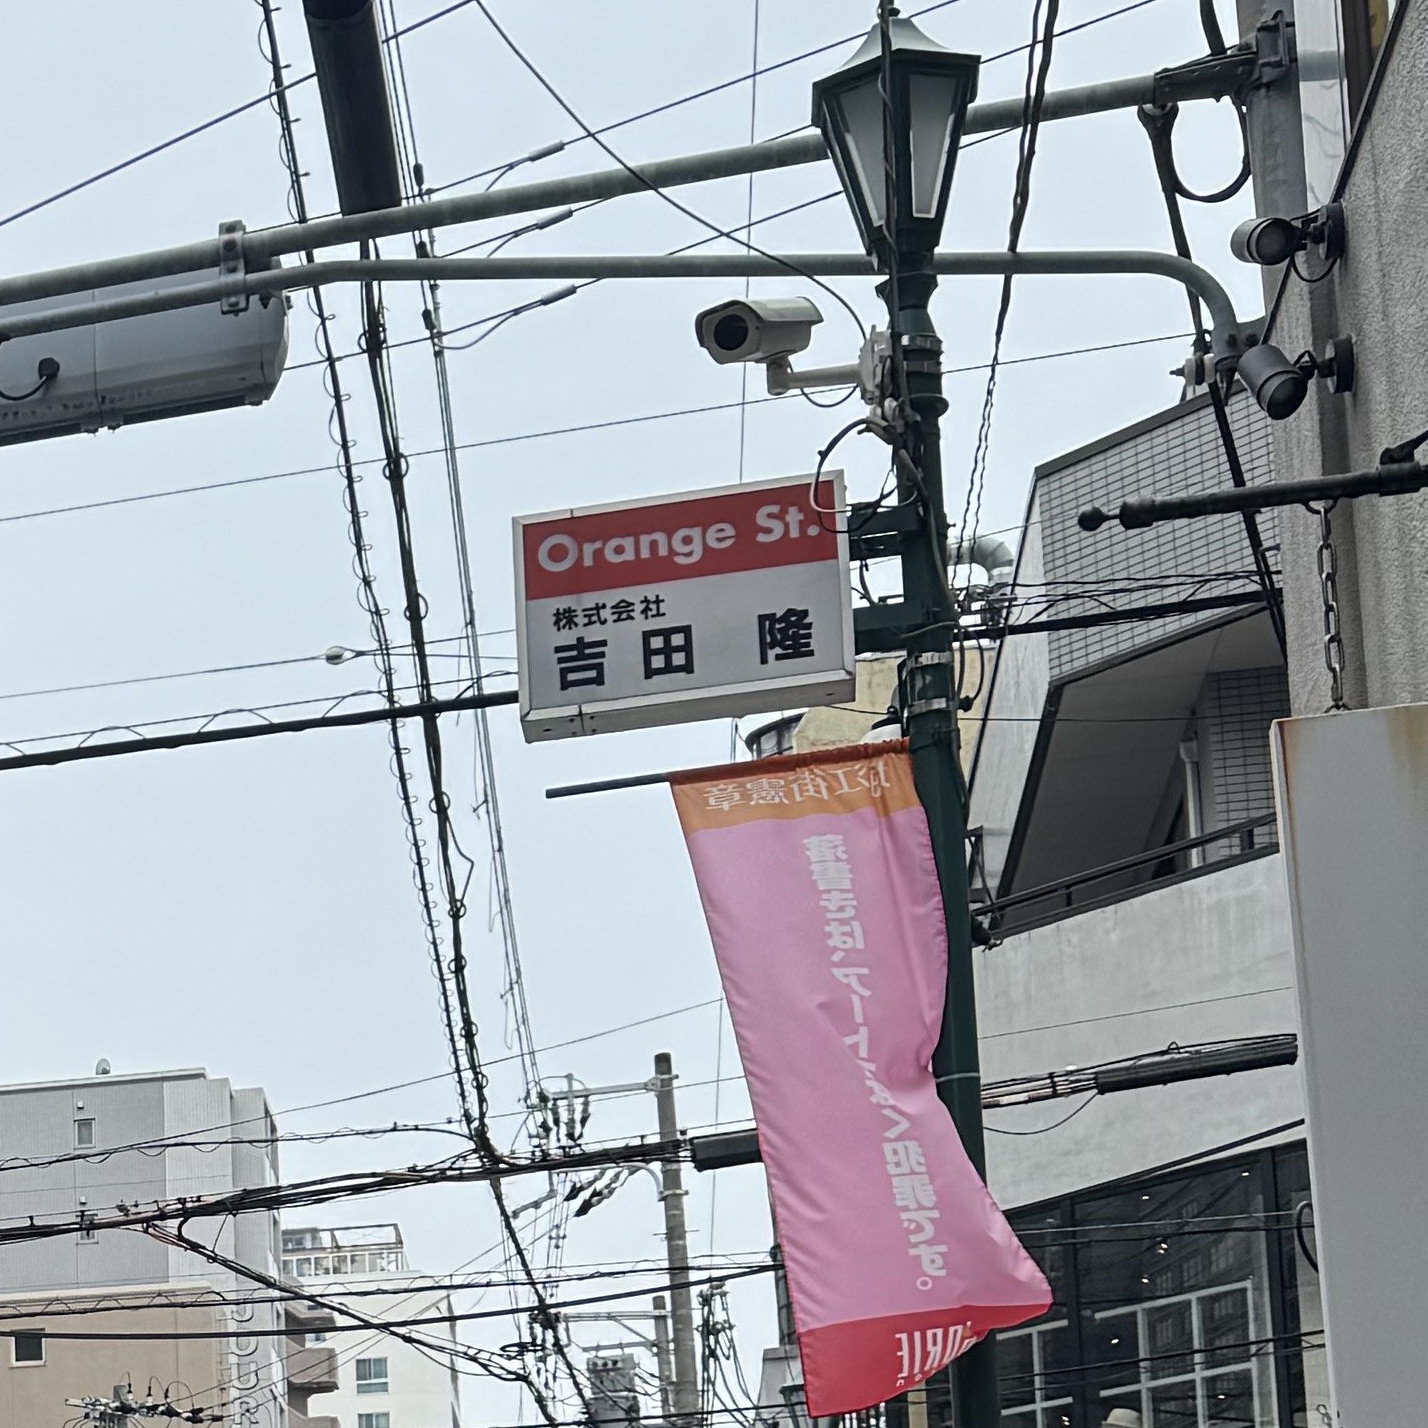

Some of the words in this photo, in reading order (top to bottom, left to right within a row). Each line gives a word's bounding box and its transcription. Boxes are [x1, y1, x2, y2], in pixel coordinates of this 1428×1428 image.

[537, 522, 737, 572] Orange
[755, 503, 820, 543] St.
[552, 595, 666, 632] 株式会社
